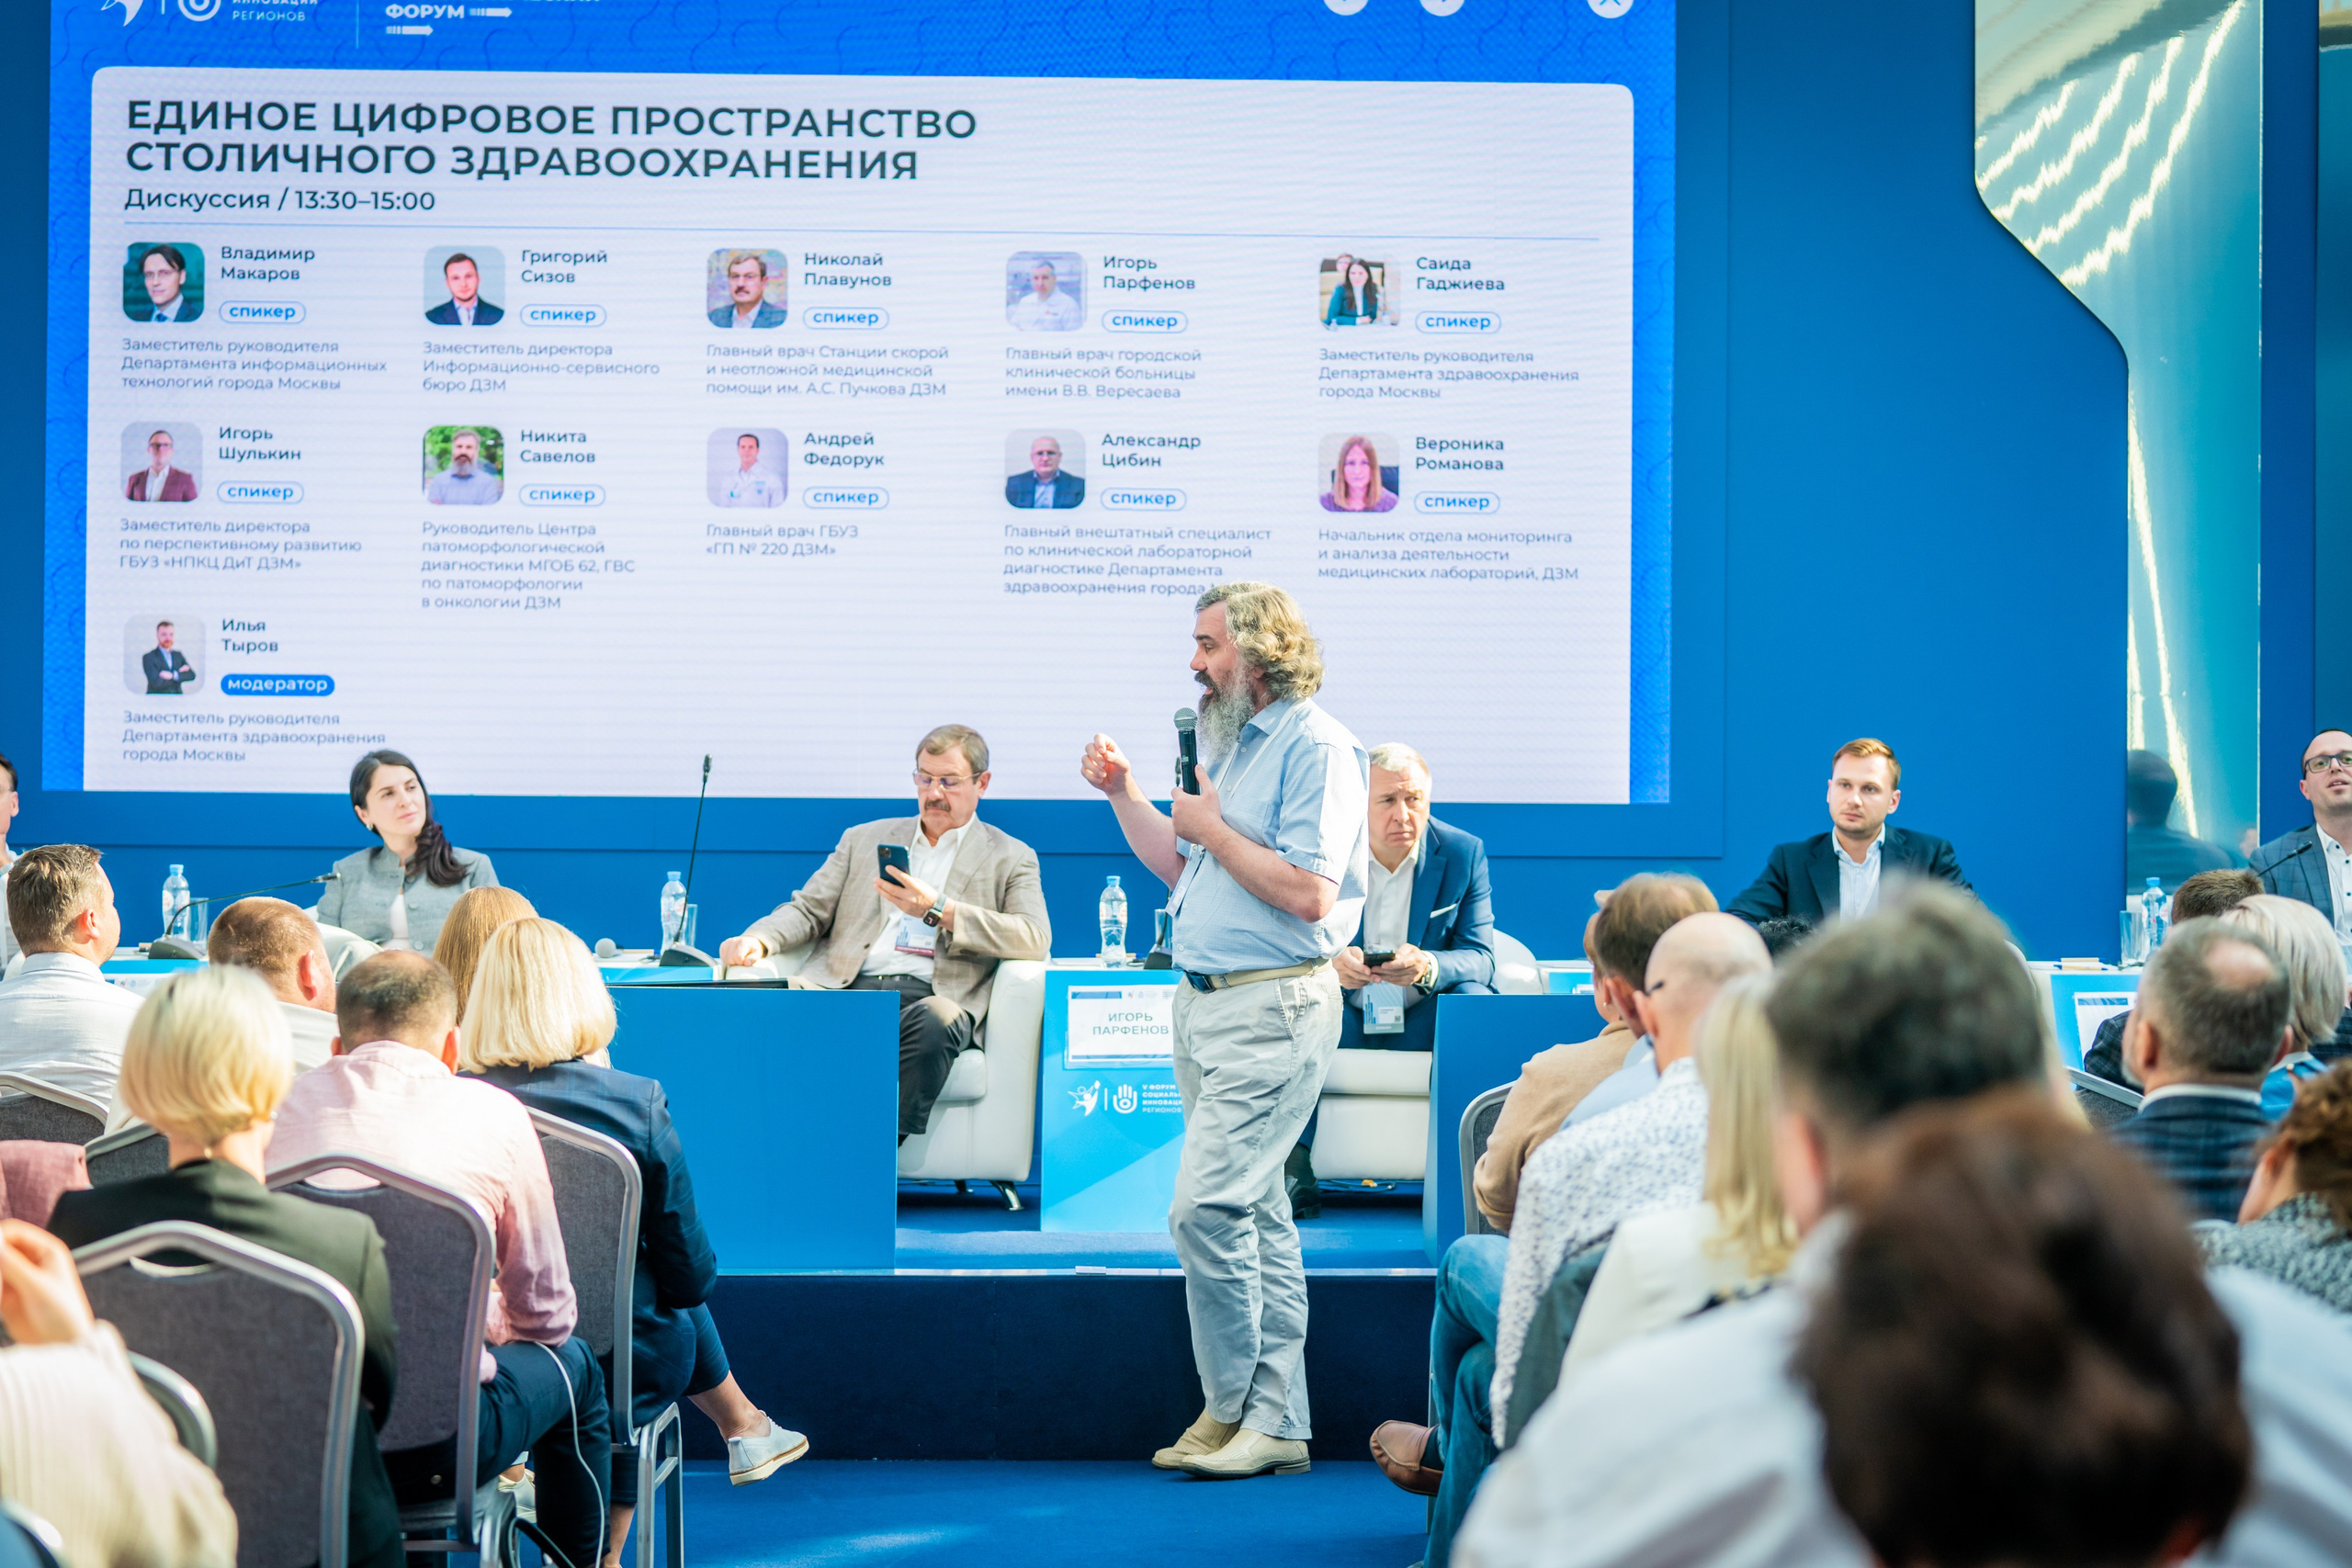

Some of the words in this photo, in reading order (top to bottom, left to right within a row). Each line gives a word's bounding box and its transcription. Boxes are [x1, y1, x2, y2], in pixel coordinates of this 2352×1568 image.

[232, 10, 306, 21] РЕГИОНОВ
[385, 4, 465, 19] ФОРУМ
[129, 101, 317, 135] ЕДИНОЕ
[334, 104, 594, 138] ЦИФРОВОЕ
[612, 107, 976, 139] ПРОСТРАНСТВО
[126, 141, 435, 175] СТОЛИЧНОГО
[450, 147, 916, 181] ЗДРАВООХРАНЕНИЯ
[123, 187, 271, 213] Дискуссия
[277, 187, 288, 211] /
[220, 245, 316, 263] Владимир
[521, 249, 608, 266] Григорий
[804, 252, 884, 266] Николай
[1102, 254, 1159, 273] Игорь
[1415, 256, 1472, 272] Саида
[220, 265, 300, 283] Макаров
[520, 268, 576, 284] Сизов
[803, 271, 892, 289] Плавунов
[1102, 275, 1196, 292] Парфенов
[1416, 276, 1506, 291] Гаджиева
[229, 304, 297, 321] спикер
[529, 308, 596, 324] спикер
[812, 310, 879, 327] спикер
[1112, 313, 1179, 330] спикер
[1425, 314, 1491, 331] спикер
[121, 336, 224, 353] Заместитель
[227, 341, 339, 356] руководителя
[423, 340, 525, 355] Заместитель
[526, 344, 614, 358] директора
[706, 343, 774, 357] Главный
[776, 346, 816, 361] врач
[819, 344, 888, 359] Станции
[890, 345, 949, 360] скорой
[1005, 346, 1073, 361] Главный
[1076, 349, 1114, 364] врач
[1117, 348, 1203, 364] городской
[1319, 347, 1420, 362] Заместитель
[1422, 351, 1535, 366] руководителя
[119, 355, 238, 373] Департамента
[241, 357, 386, 374] информационных
[423, 358, 661, 377] Информационно-сервисного
[706, 365, 717, 375] и
[720, 362, 819, 377] неотложной
[822, 363, 933, 378] медицинской
[1005, 365, 1111, 379] клинической
[1114, 365, 1196, 380] больницы
[120, 374, 214, 389] технологий
[217, 378, 274, 392] города
[277, 377, 341, 390] Москвы
[1317, 366, 1433, 382] Департамента
[1437, 369, 1580, 384] здравоохранения
[422, 376, 467, 393] бюро
[468, 377, 507, 394] ДЗМ
[706, 382, 773, 397] помощи
[776, 384, 802, 395] им.
[805, 380, 835, 395] А.С.
[839, 380, 907, 399] Пучкова
[909, 381, 946, 397] ДЗМ
[1005, 386, 1058, 398] имени
[1062, 384, 1091, 399] В.В.
[1095, 384, 1182, 400] Вересаева
[1318, 386, 1374, 400] города
[1378, 385, 1442, 400] Москвы
[219, 426, 274, 443] Игорь
[520, 429, 587, 444] Никита
[804, 431, 875, 448] Андрей
[1101, 433, 1202, 450] Александр
[1415, 435, 1505, 454] Вероника
[218, 446, 301, 464] Шулькин
[519, 448, 596, 463] Савелов
[803, 451, 885, 469] Федорук
[1102, 452, 1162, 468] Цибин
[1415, 456, 1505, 471] Романова
[227, 485, 294, 502] спикер
[529, 488, 596, 504] спикер
[812, 491, 879, 507] спикер
[1110, 491, 1177, 508] спикер
[1424, 494, 1490, 511] спикер
[119, 517, 222, 533] Заместитель
[223, 521, 311, 536] директора
[422, 520, 535, 537] Руководитель
[537, 523, 597, 538] Центра
[706, 523, 774, 538] Главный
[776, 526, 816, 540] врач
[819, 524, 859, 538] ГБУЗ
[1004, 524, 1071, 538] Главный
[1075, 525, 1174, 540] внештатный
[1177, 529, 1272, 543] специалист
[119, 538, 141, 550] по
[143, 538, 280, 554] перспективному
[283, 541, 362, 554] развитию
[1318, 529, 1405, 542] Начальник
[1408, 531, 1464, 544] отдела
[1466, 532, 1573, 547] мониторинга
[421, 540, 605, 556] патоморфологической
[706, 541, 735, 556] «ГП
[738, 542, 757, 557] №
[761, 542, 789, 557] 220
[791, 542, 837, 558] ДЗМ»
[1003, 545, 1024, 557] по
[1027, 545, 1134, 558] клинической
[1136, 543, 1253, 560] лабораторной
[1317, 549, 1329, 560] и
[1332, 548, 1397, 561] анализа
[1399, 549, 1510, 563] деятельности
[119, 554, 160, 569] ГБУЗ
[163, 554, 220, 570] «НПКЦ
[221, 556, 253, 570] ДиТ
[256, 556, 302, 571] ДЗМ»
[420, 559, 525, 573] диагностики
[527, 558, 575, 573] МГОБ
[577, 559, 600, 574] 62,
[604, 559, 635, 573] ГВС
[1002, 563, 1105, 577] диагностике
[1107, 562, 1224, 579] Департамента
[1317, 567, 1427, 581] медицинских
[1430, 565, 1539, 581] лабораторий,
[1541, 566, 1579, 582] ДЗМ
[421, 578, 442, 590] по
[445, 576, 583, 593] патоморфологии
[1003, 581, 1146, 597] здравоохранения
[1150, 583, 1205, 597] города
[421, 596, 431, 609] в
[434, 596, 521, 610] онкологии
[523, 595, 561, 610] ДЗМ
[221, 618, 266, 632] Илья
[220, 637, 279, 655] Тыров
[227, 678, 328, 694] модератор
[123, 709, 225, 725] Заместитель
[228, 714, 341, 728] руководителя
[121, 728, 239, 744] Департамента
[243, 732, 386, 747] здравоохранения
[122, 749, 178, 763] города
[182, 749, 246, 761] Москвы
[1108, 1012, 1153, 1022] ИГОРЬ
[1092, 1025, 1170, 1035] ПАРФЕНОВ
